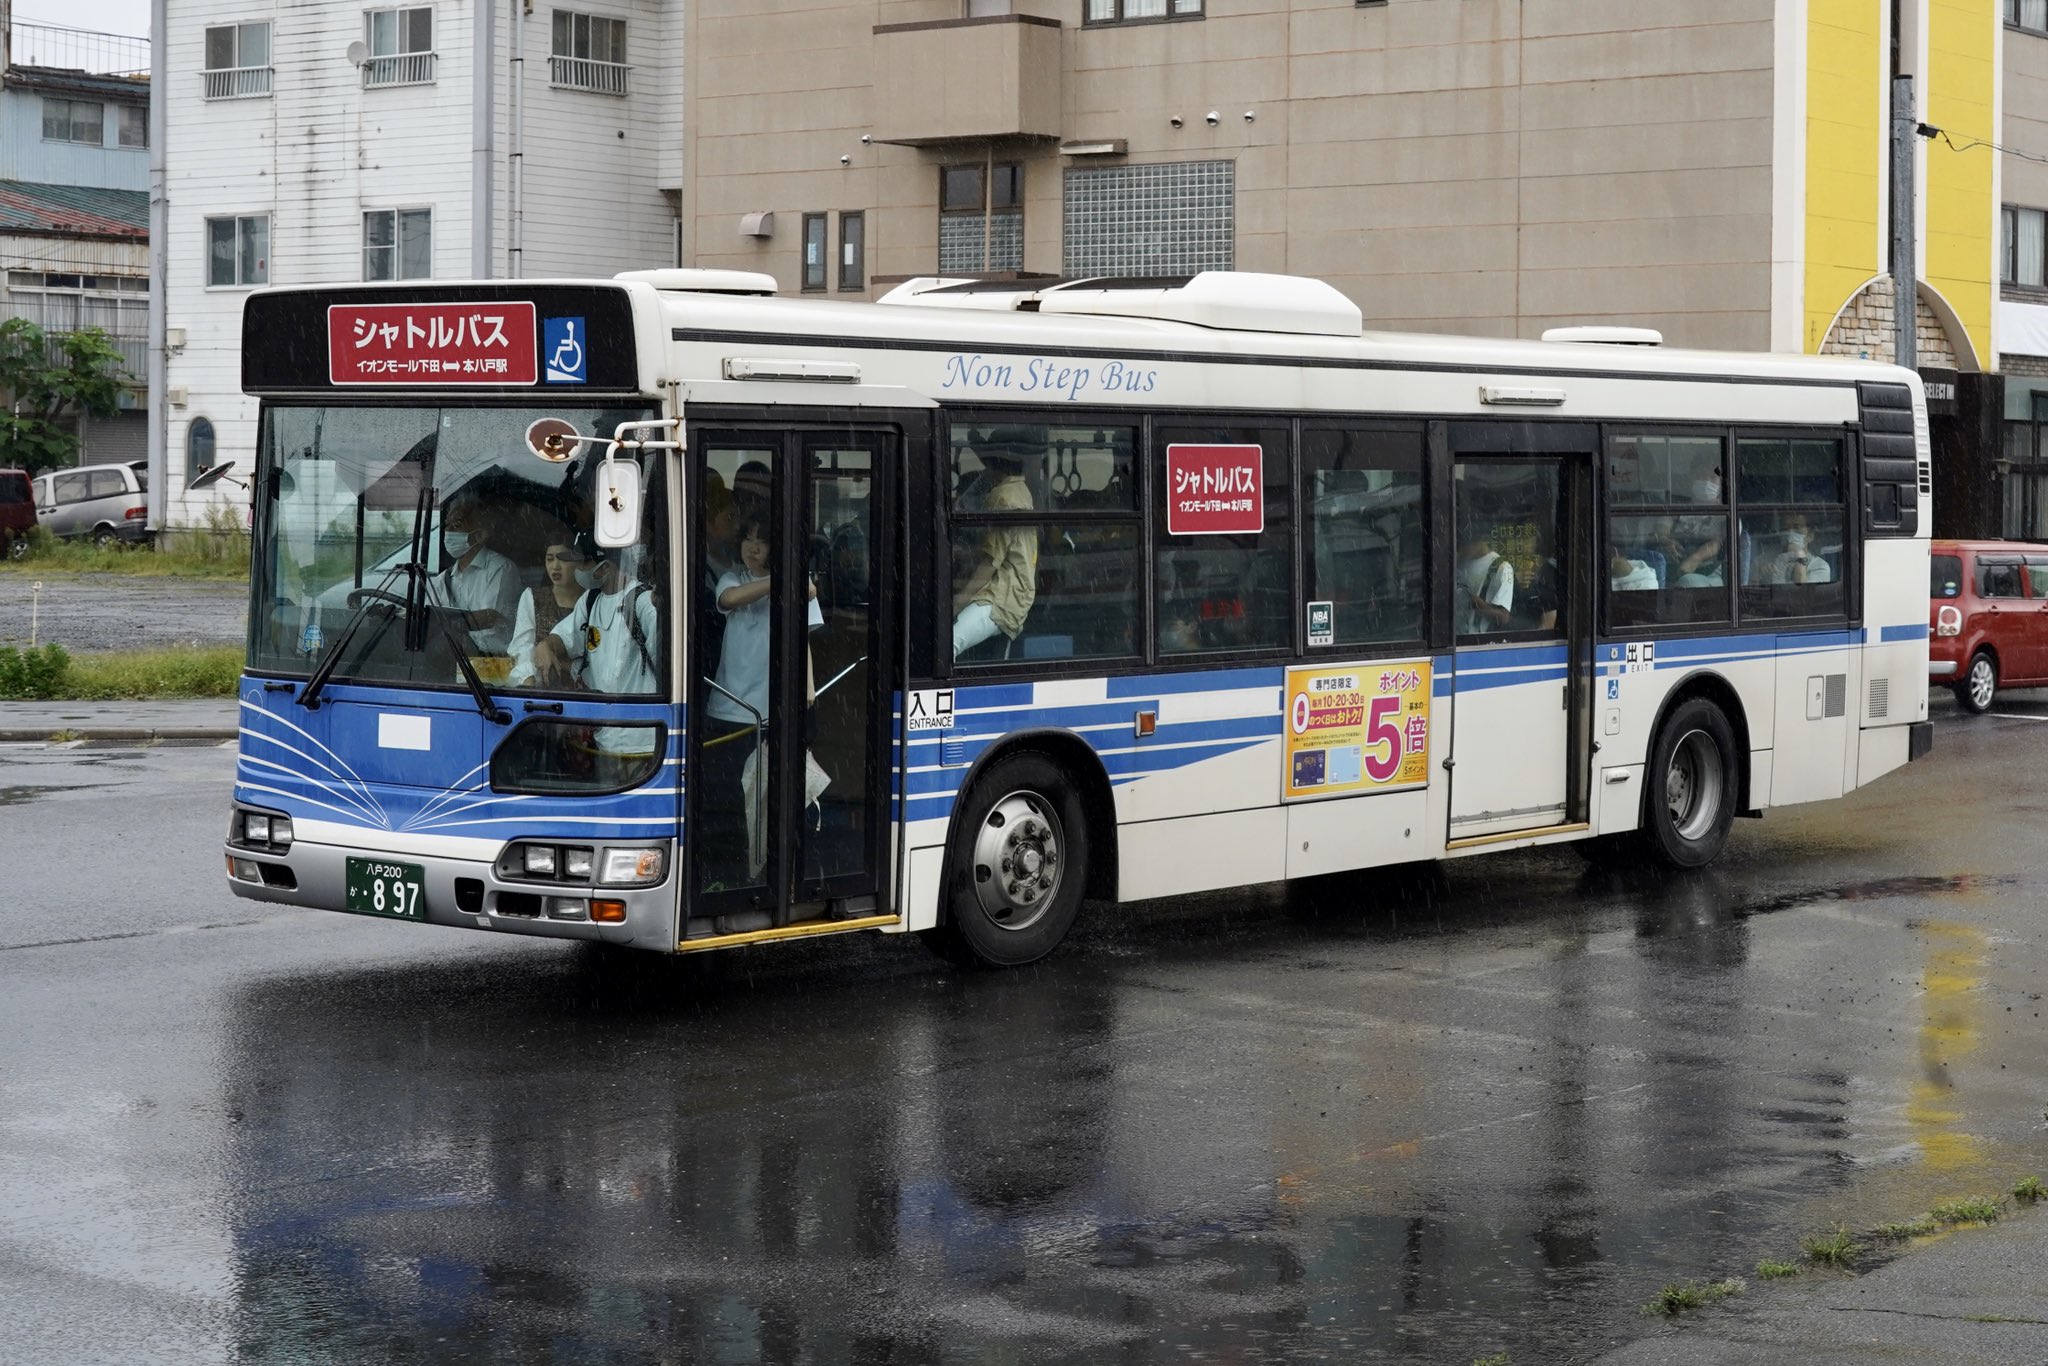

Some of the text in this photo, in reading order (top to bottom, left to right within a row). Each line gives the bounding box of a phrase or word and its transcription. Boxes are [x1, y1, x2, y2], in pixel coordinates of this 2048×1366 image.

[353, 313, 509, 349] シャトルバス
[356, 358, 508, 373] イオンモール下田 本八戸駅
[942, 355, 1157, 401] Non Step Bus
[1176, 466, 1255, 494] シャトルバス
[1312, 611, 1328, 623] NBA
[1627, 643, 1654, 663] 出口
[1631, 663, 1648, 673] EXIT
[1316, 677, 1352, 690] 専門店限定
[1379, 670, 1419, 691] ポイント
[910, 690, 953, 717] 入口
[909, 716, 952, 729] ENTRANCE
[1365, 696, 1426, 780] 5 倍
[366, 863, 402, 878] 八戸200
[349, 886, 358, 897] か
